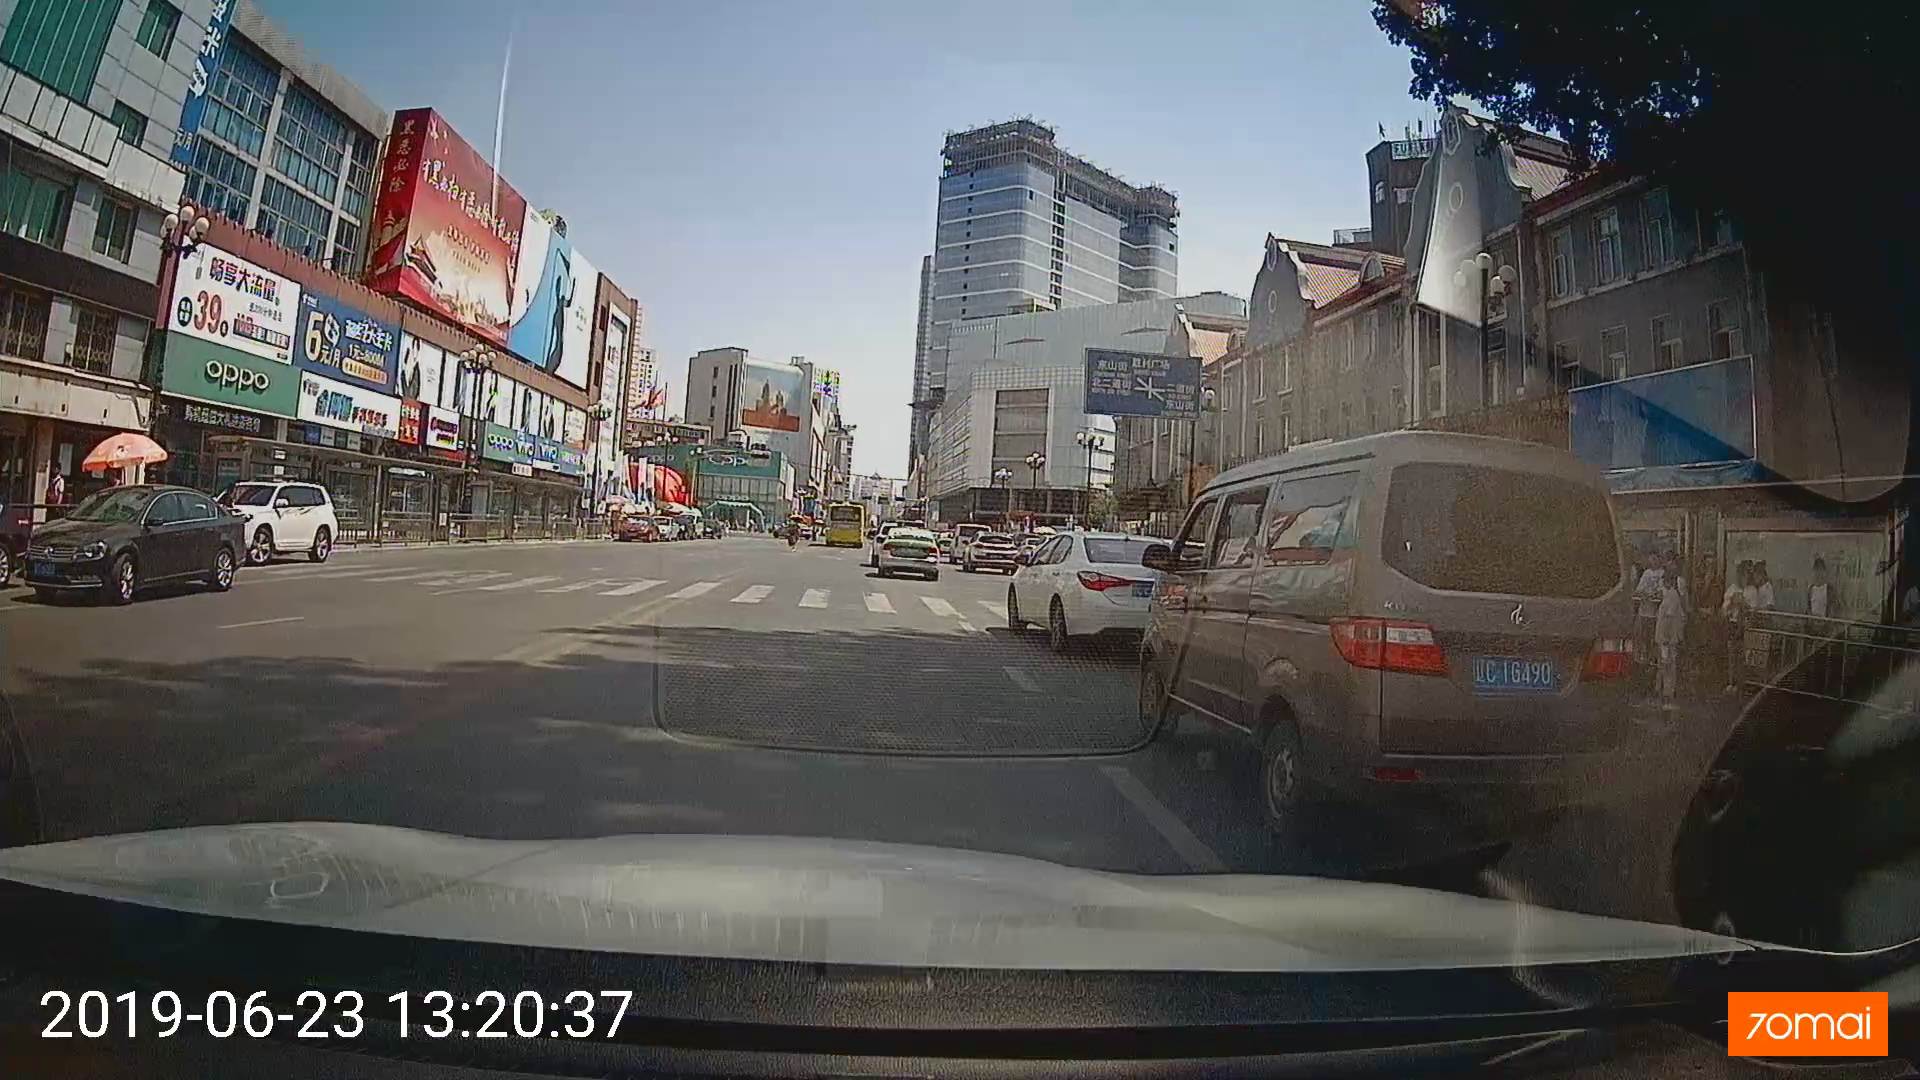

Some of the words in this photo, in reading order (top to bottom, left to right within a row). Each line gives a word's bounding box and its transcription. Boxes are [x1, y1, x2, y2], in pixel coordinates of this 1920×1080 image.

[209, 257, 276, 303] 畅享大流量
[193, 290, 222, 335] 39
